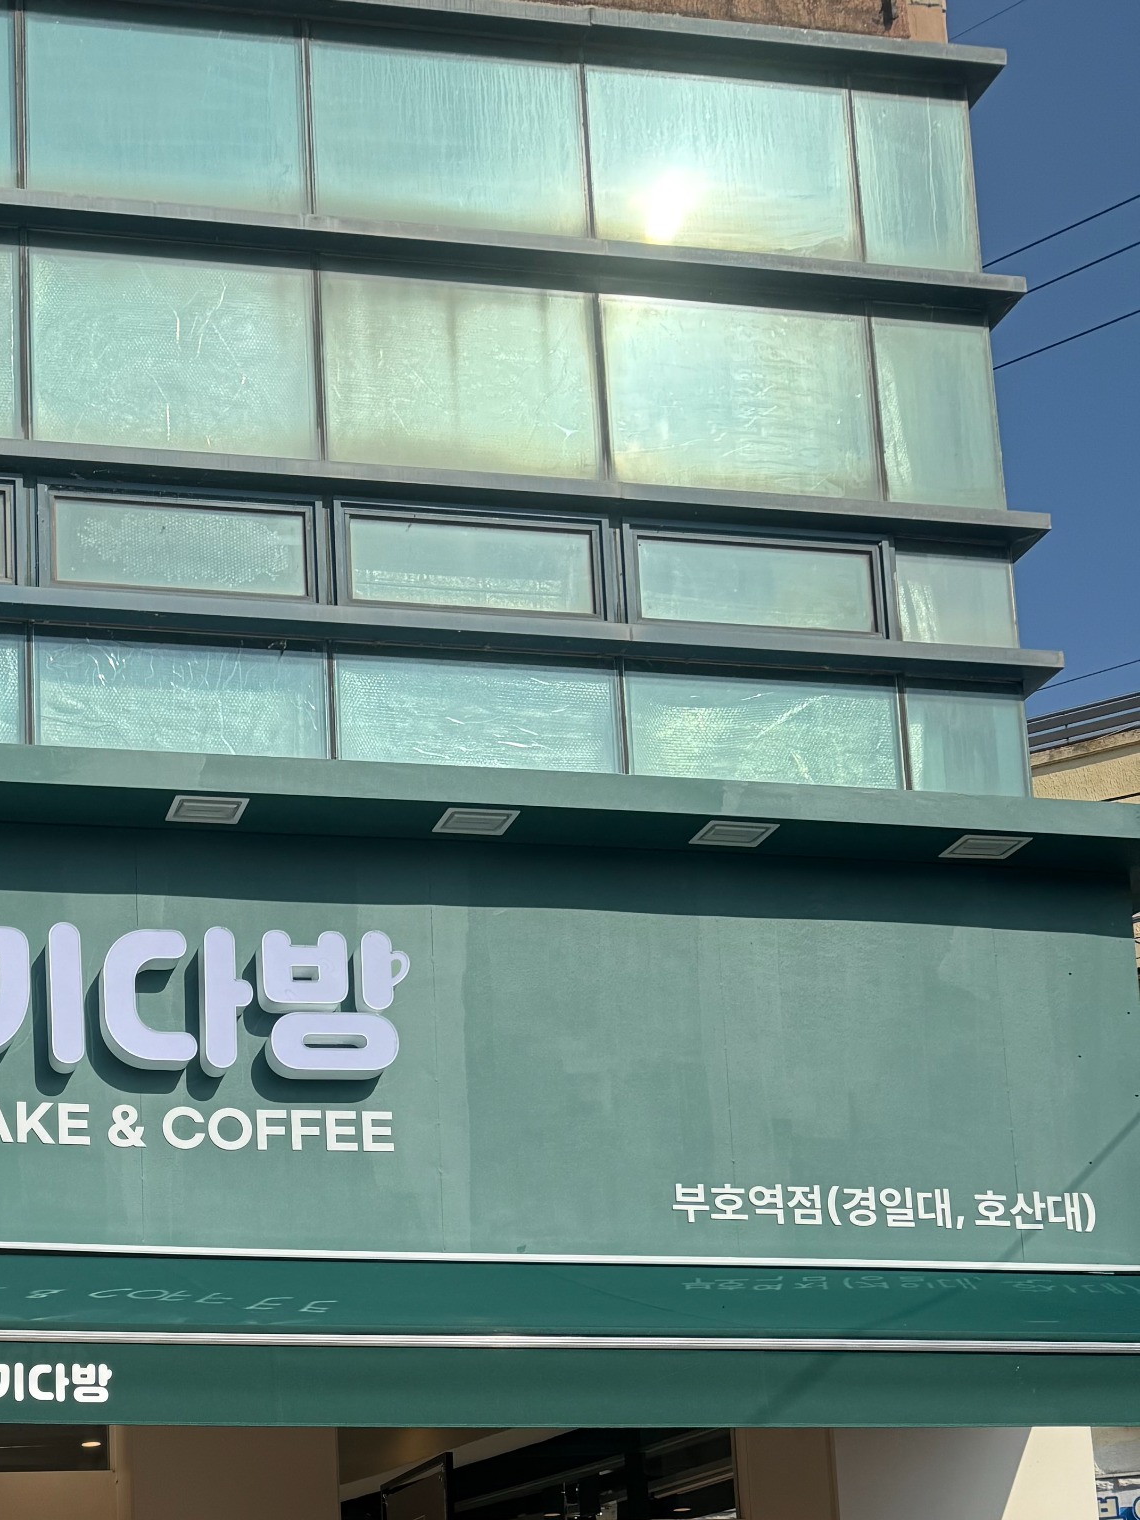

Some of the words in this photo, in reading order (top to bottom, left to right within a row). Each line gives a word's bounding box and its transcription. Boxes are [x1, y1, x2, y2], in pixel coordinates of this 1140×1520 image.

[106, 1105, 146, 1148] &
[159, 1105, 394, 1152] COFFEE
[672, 1183, 964, 1230] 부호역점(경일대,
[974, 1189, 1096, 1232] 호산대)
